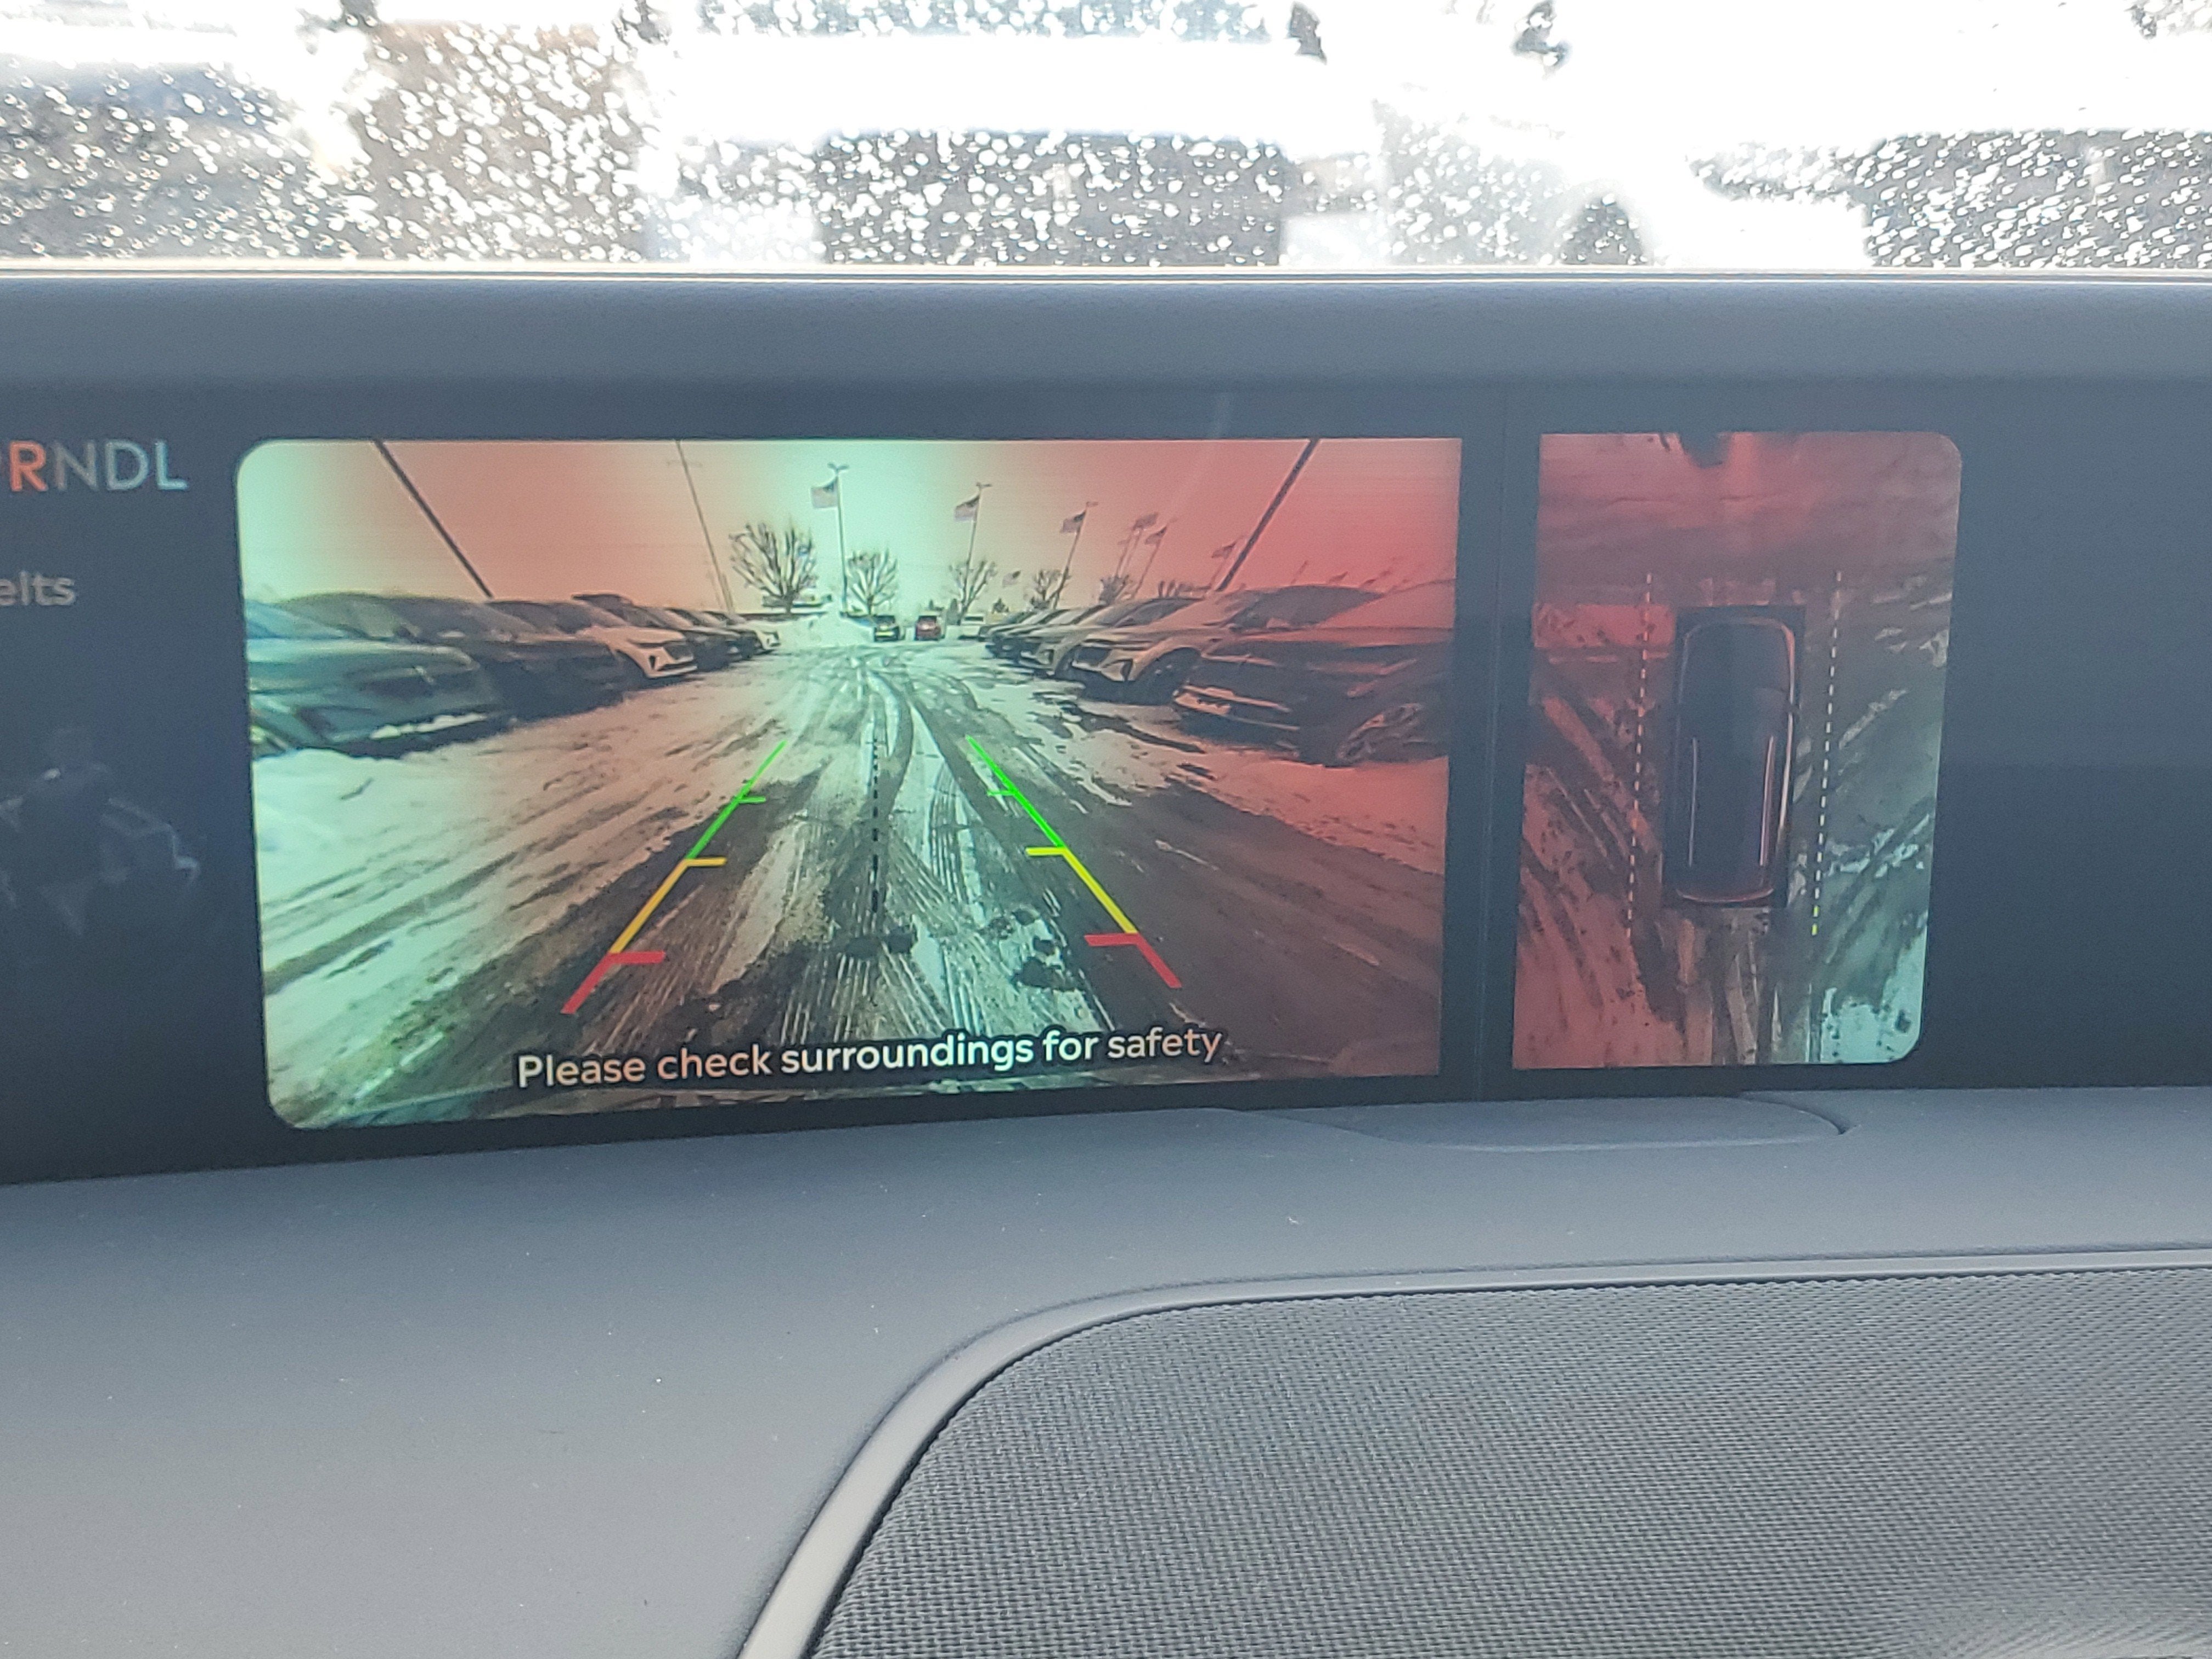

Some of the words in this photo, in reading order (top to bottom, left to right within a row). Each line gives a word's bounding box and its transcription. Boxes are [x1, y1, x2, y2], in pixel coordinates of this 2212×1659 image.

[0, 439, 189, 491] RNDL
[518, 1054, 646, 1089] Please
[657, 1045, 772, 1080] check
[781, 1032, 1035, 1071] surroundings
[1042, 1029, 1099, 1061] for
[1107, 1028, 1223, 1063] safety
